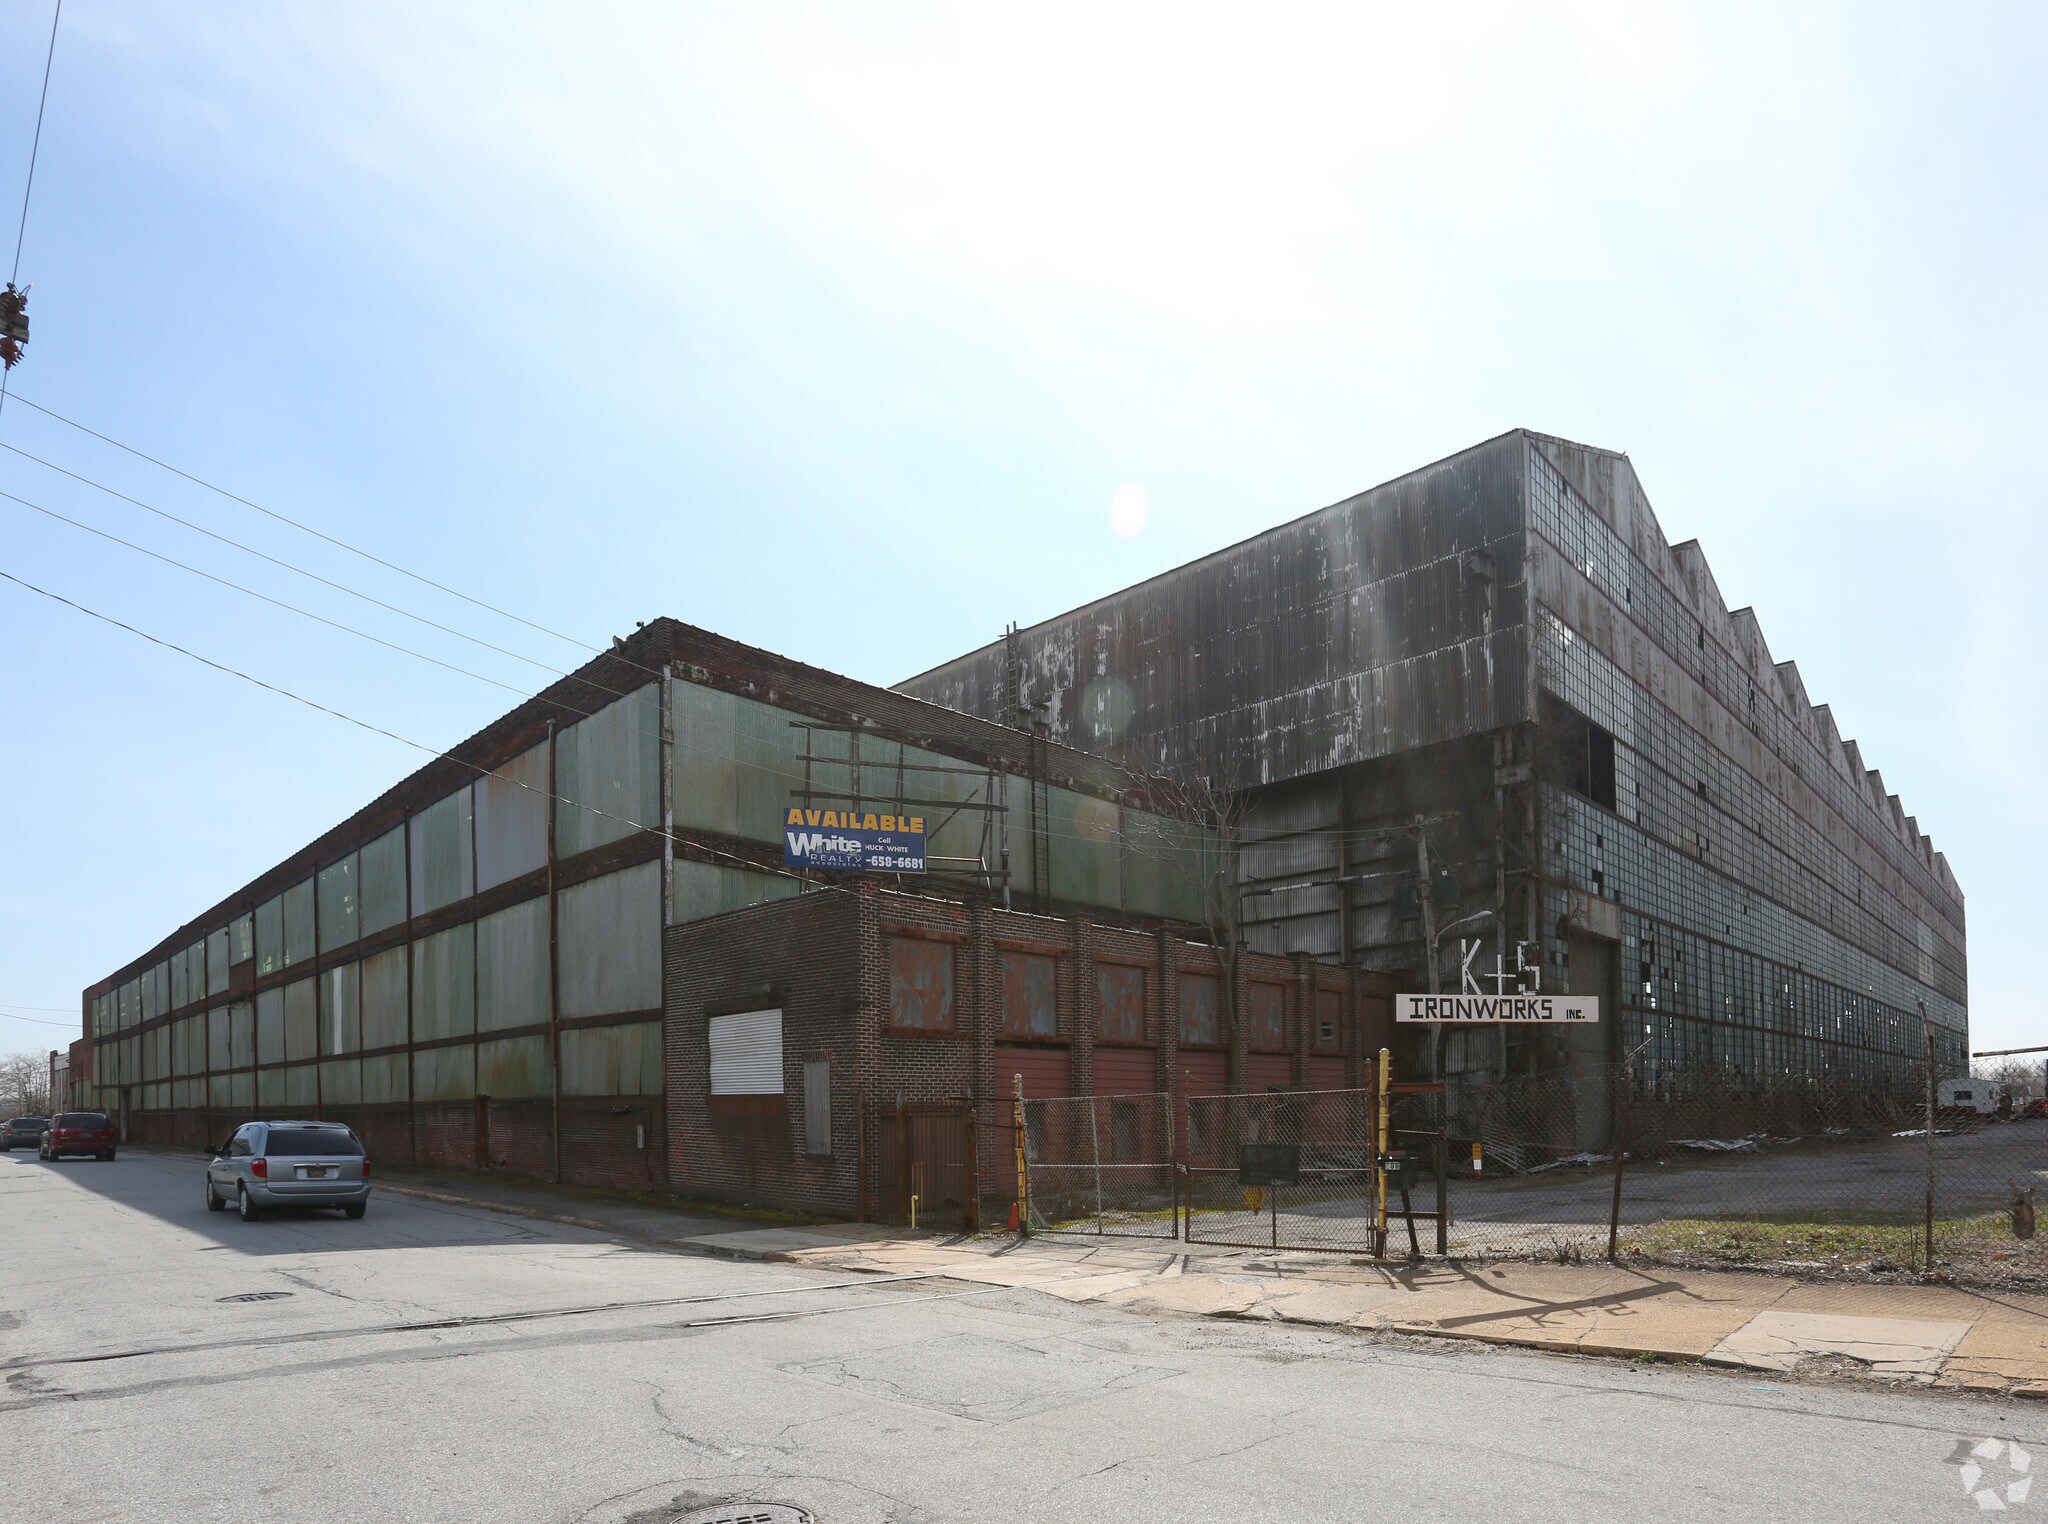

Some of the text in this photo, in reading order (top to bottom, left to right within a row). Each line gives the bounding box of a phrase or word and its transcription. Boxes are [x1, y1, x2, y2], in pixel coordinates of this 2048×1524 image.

[787, 808, 924, 833] AVAILABLE
[787, 832, 861, 856] White
[810, 853, 862, 862] REALTY
[1409, 997, 1586, 1020] IRONWORKS INC.
